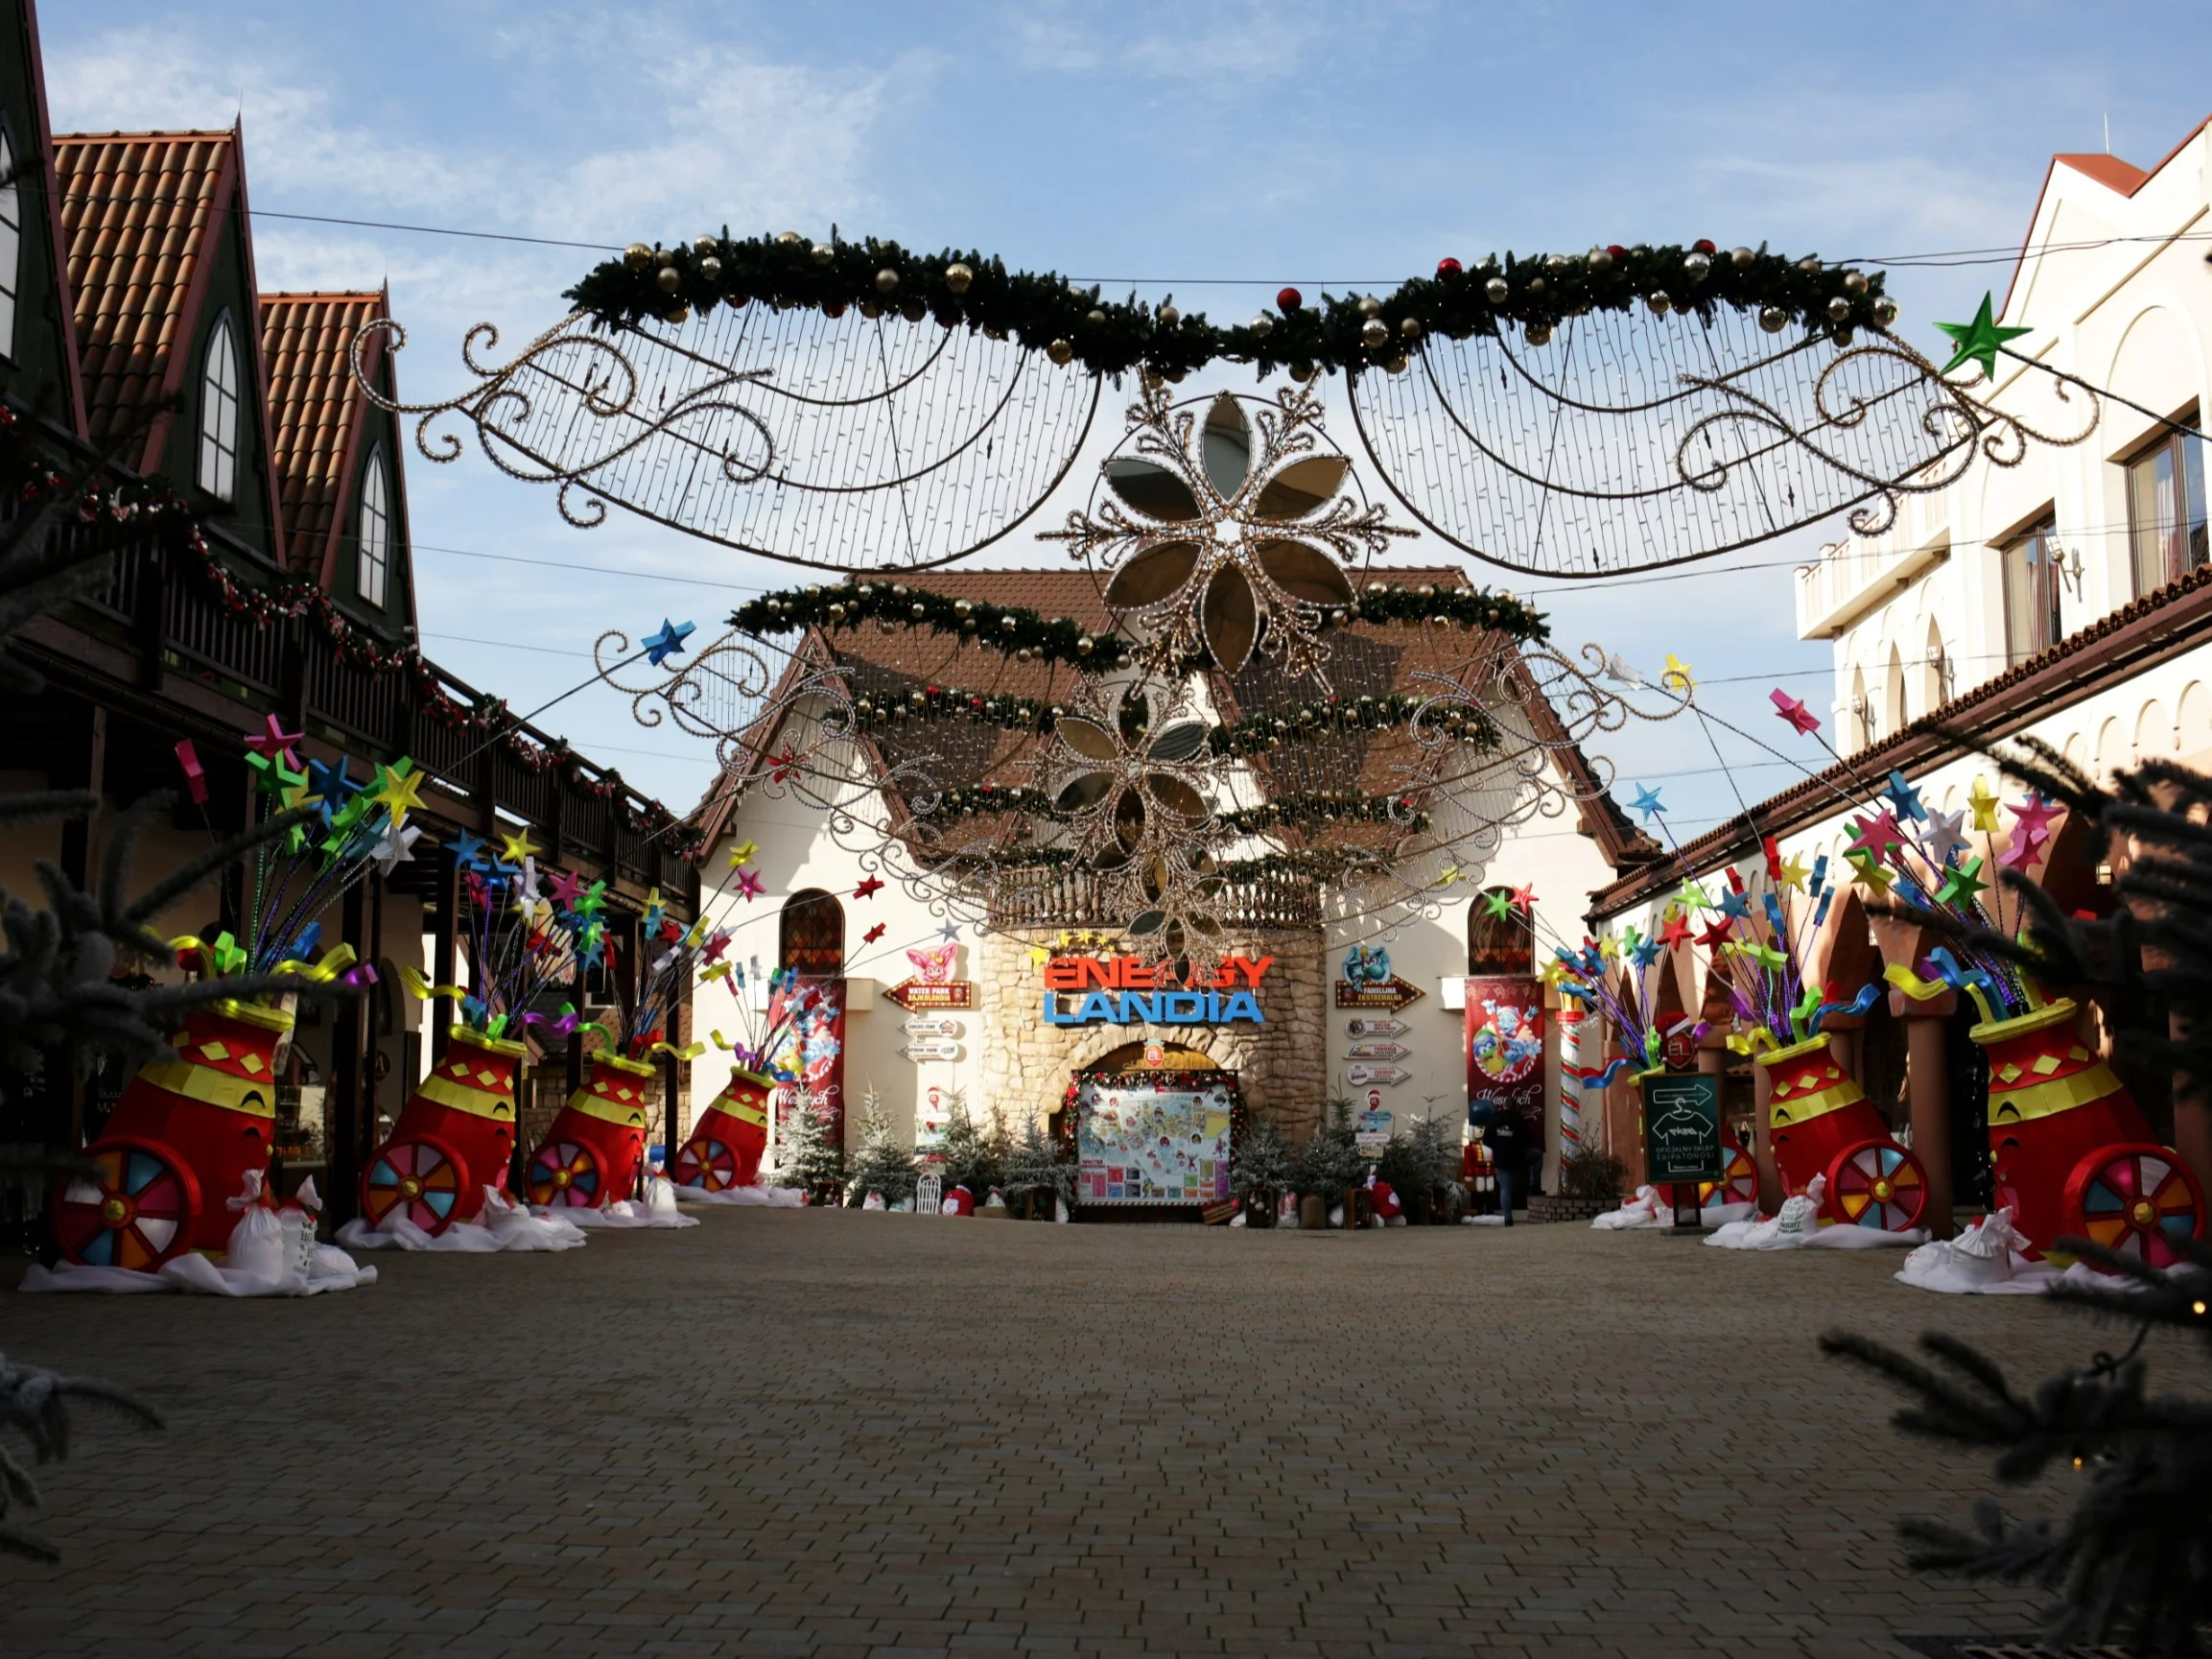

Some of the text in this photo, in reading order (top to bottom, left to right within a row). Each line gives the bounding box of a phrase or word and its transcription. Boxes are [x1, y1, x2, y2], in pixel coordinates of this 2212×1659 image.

[1044, 991, 1265, 1023] LANDIA
[1668, 1042, 1690, 1056] EL
[778, 1084, 840, 1106] Weych
[1476, 1083, 1542, 1105] Wesch
[1656, 1144, 1715, 1153] OFICJALNY SKLEP
[1657, 1151, 1714, 1161] EKIPATONOSI
